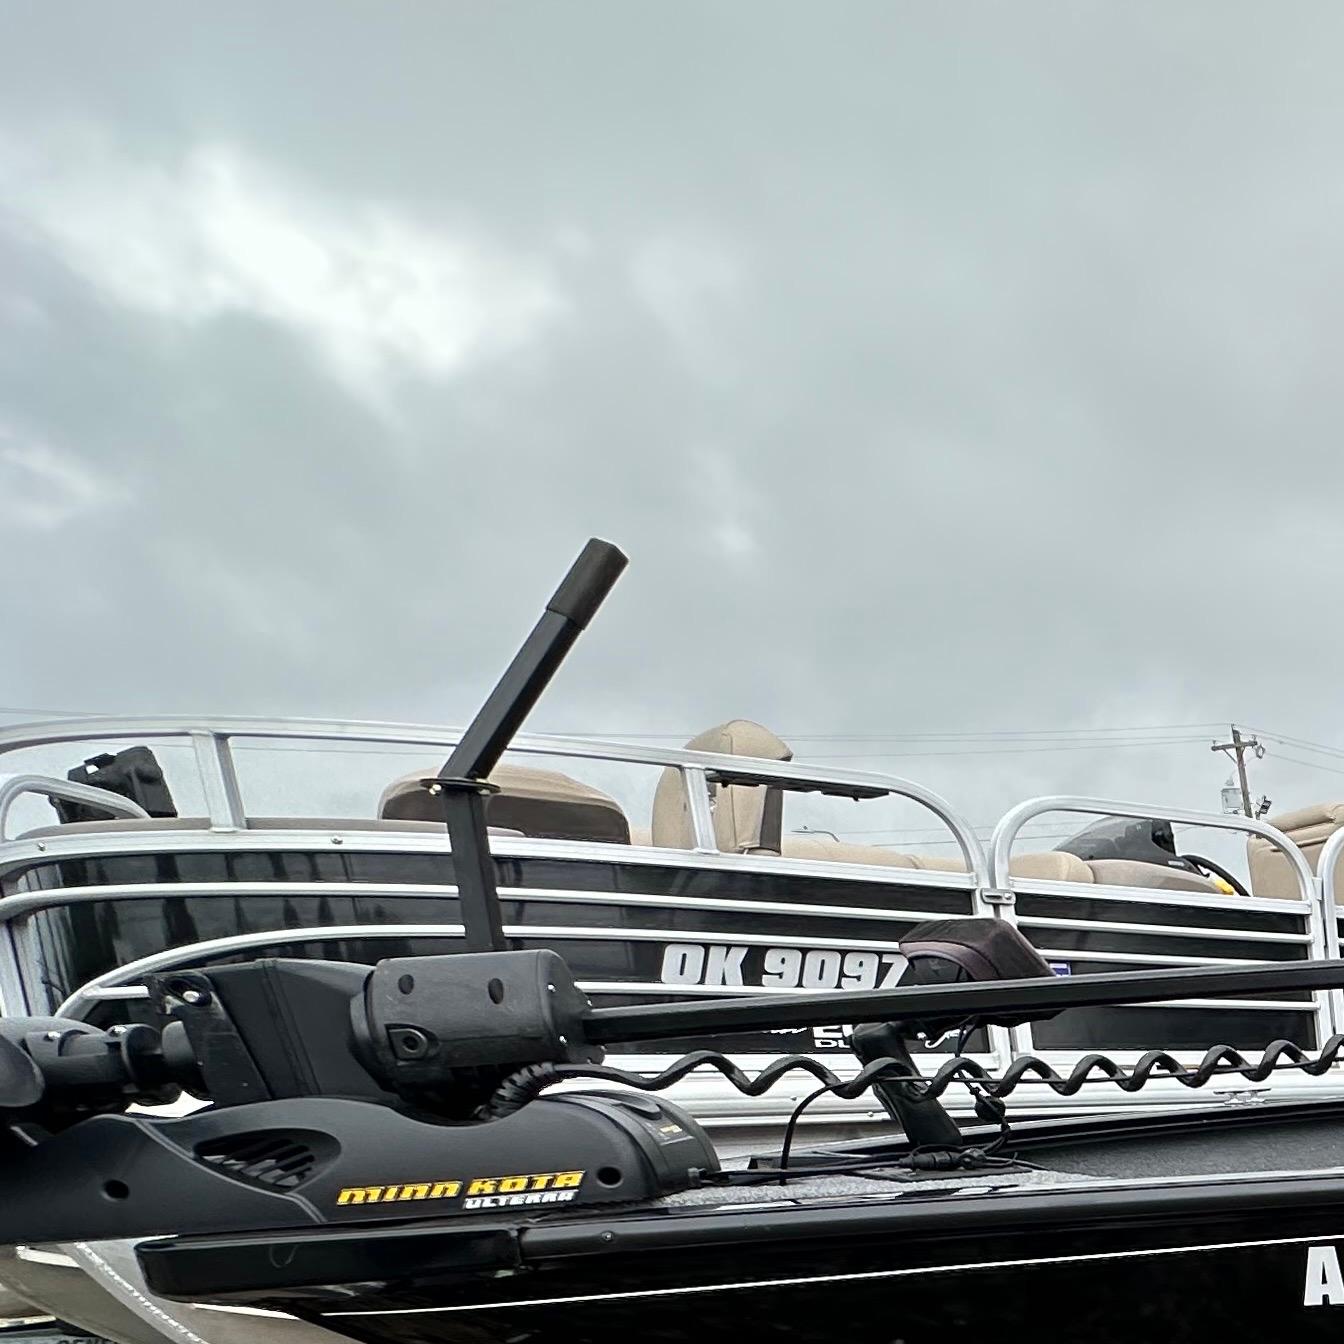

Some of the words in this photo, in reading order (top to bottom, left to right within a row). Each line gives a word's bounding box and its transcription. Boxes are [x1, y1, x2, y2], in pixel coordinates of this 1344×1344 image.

[661, 943, 749, 987] OK
[761, 948, 910, 990] 9097
[337, 1180, 464, 1206] MINN
[465, 1169, 587, 1197] KOTA
[462, 1189, 580, 1210] ULTERRA
